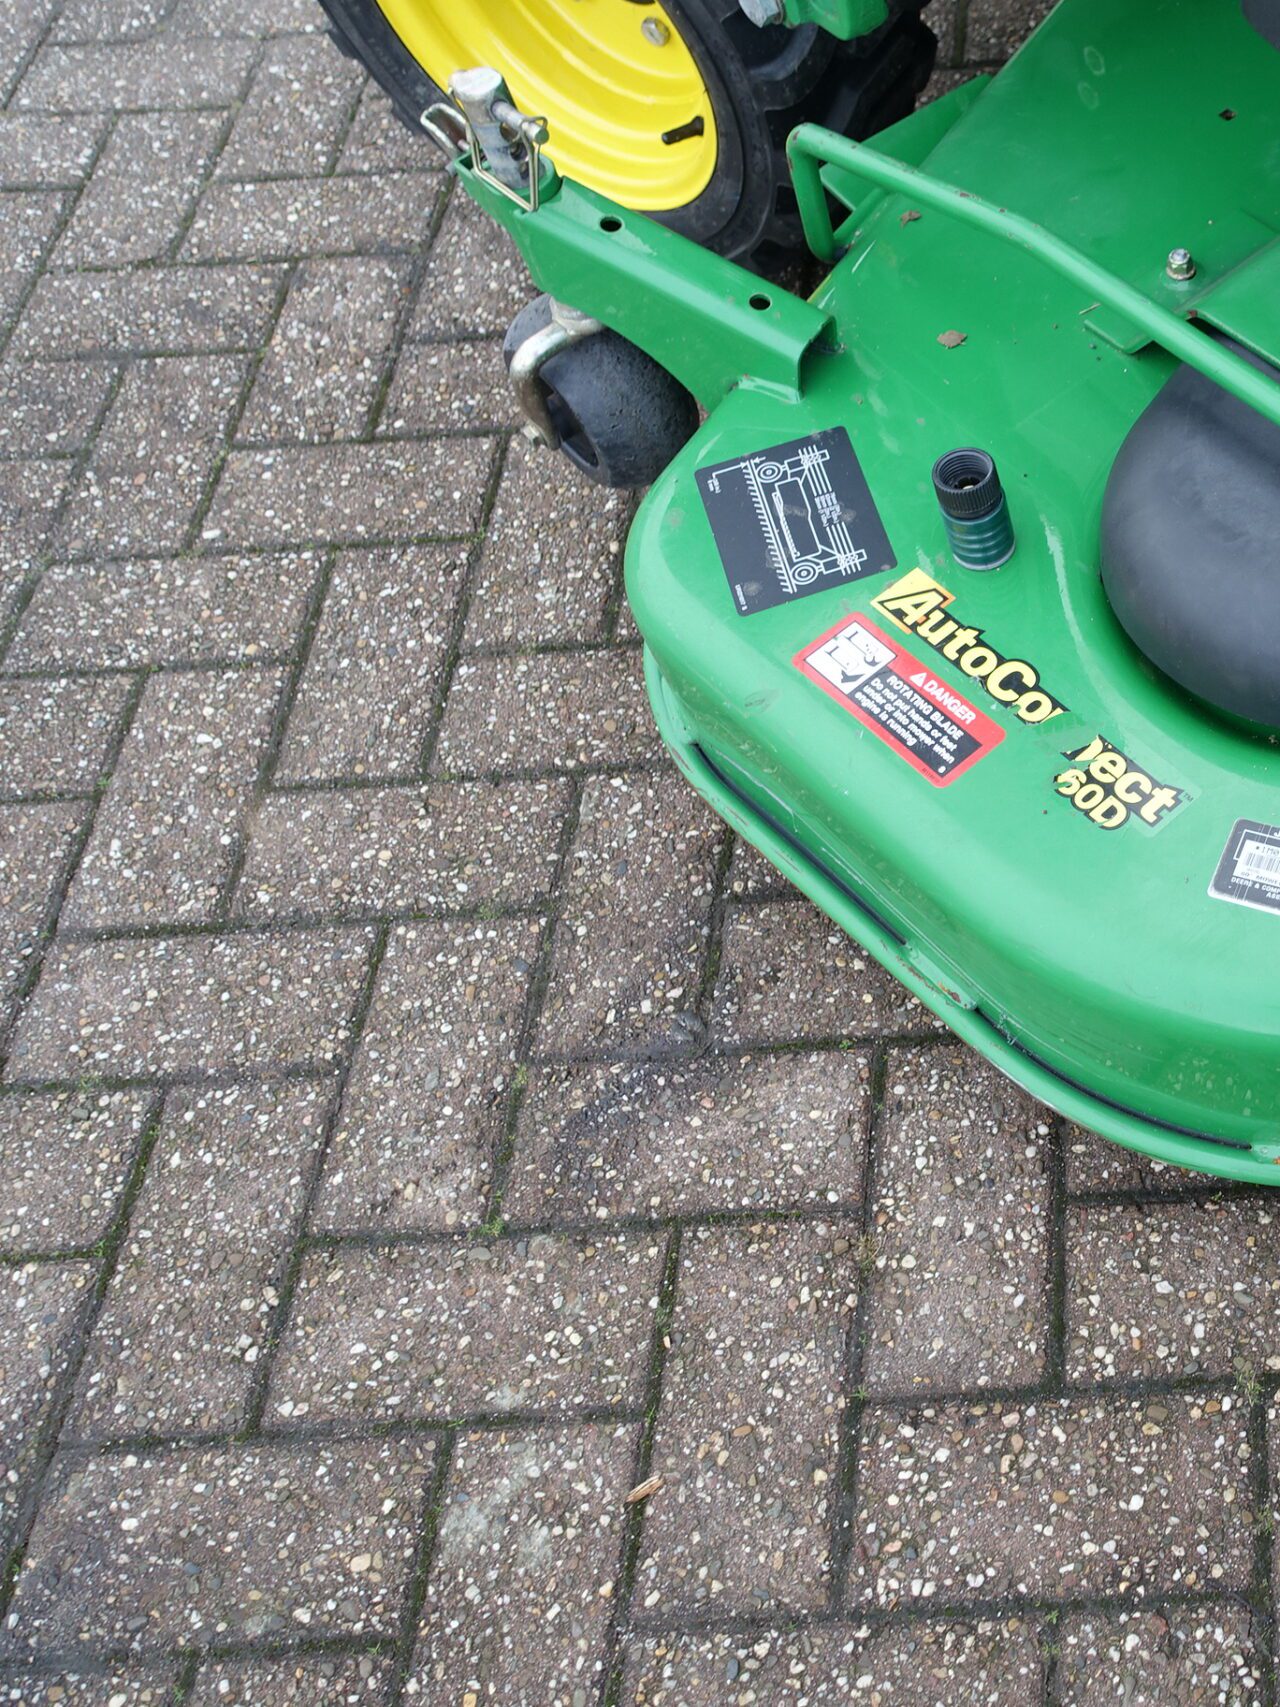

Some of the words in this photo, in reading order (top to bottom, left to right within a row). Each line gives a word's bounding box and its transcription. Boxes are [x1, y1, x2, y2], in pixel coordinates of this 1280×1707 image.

[853, 691, 880, 714] engine
[878, 712, 889, 721] is
[886, 719, 917, 746] running
[862, 684, 887, 705] under
[883, 703, 895, 713] or
[892, 708, 909, 725] into
[906, 723, 935, 747] mower
[932, 743, 955, 763] when
[870, 677, 884, 689] Do
[881, 687, 897, 701] not
[892, 697, 910, 712] put
[907, 708, 933, 731] hands
[930, 729, 942, 739] or
[939, 735, 957, 752] feet
[885, 675, 933, 715] ROTATING
[929, 711, 964, 740] BLADE
[922, 679, 977, 725] DANGER
[1231, 877, 1252, 886] DEERE
